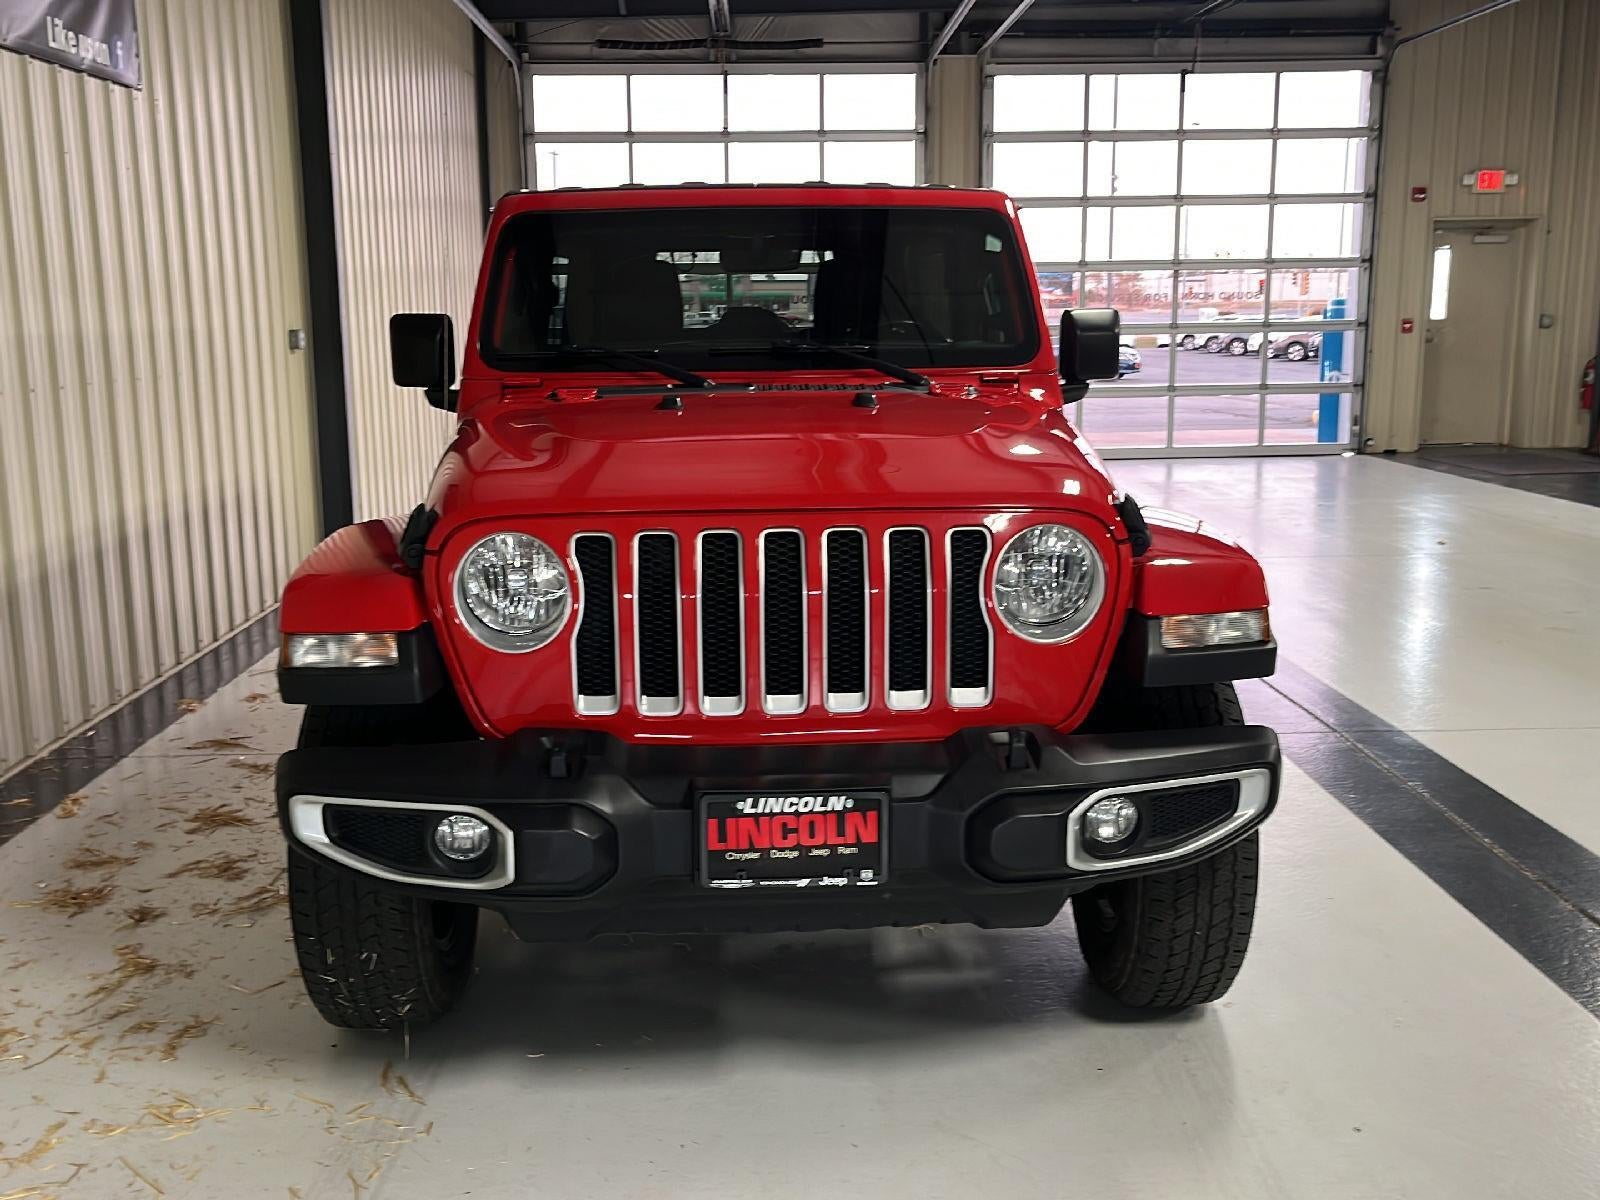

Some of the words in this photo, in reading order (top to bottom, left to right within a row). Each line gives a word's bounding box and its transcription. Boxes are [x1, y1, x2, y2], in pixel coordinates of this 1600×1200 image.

[46, 16, 78, 54] Like
[742, 796, 848, 814] LINCOLN
[707, 810, 878, 851] LINCOLN
[769, 849, 800, 859] Dodge
[808, 848, 831, 857] Jeep
[837, 846, 858, 854] Ram
[818, 876, 849, 886] Jeep
